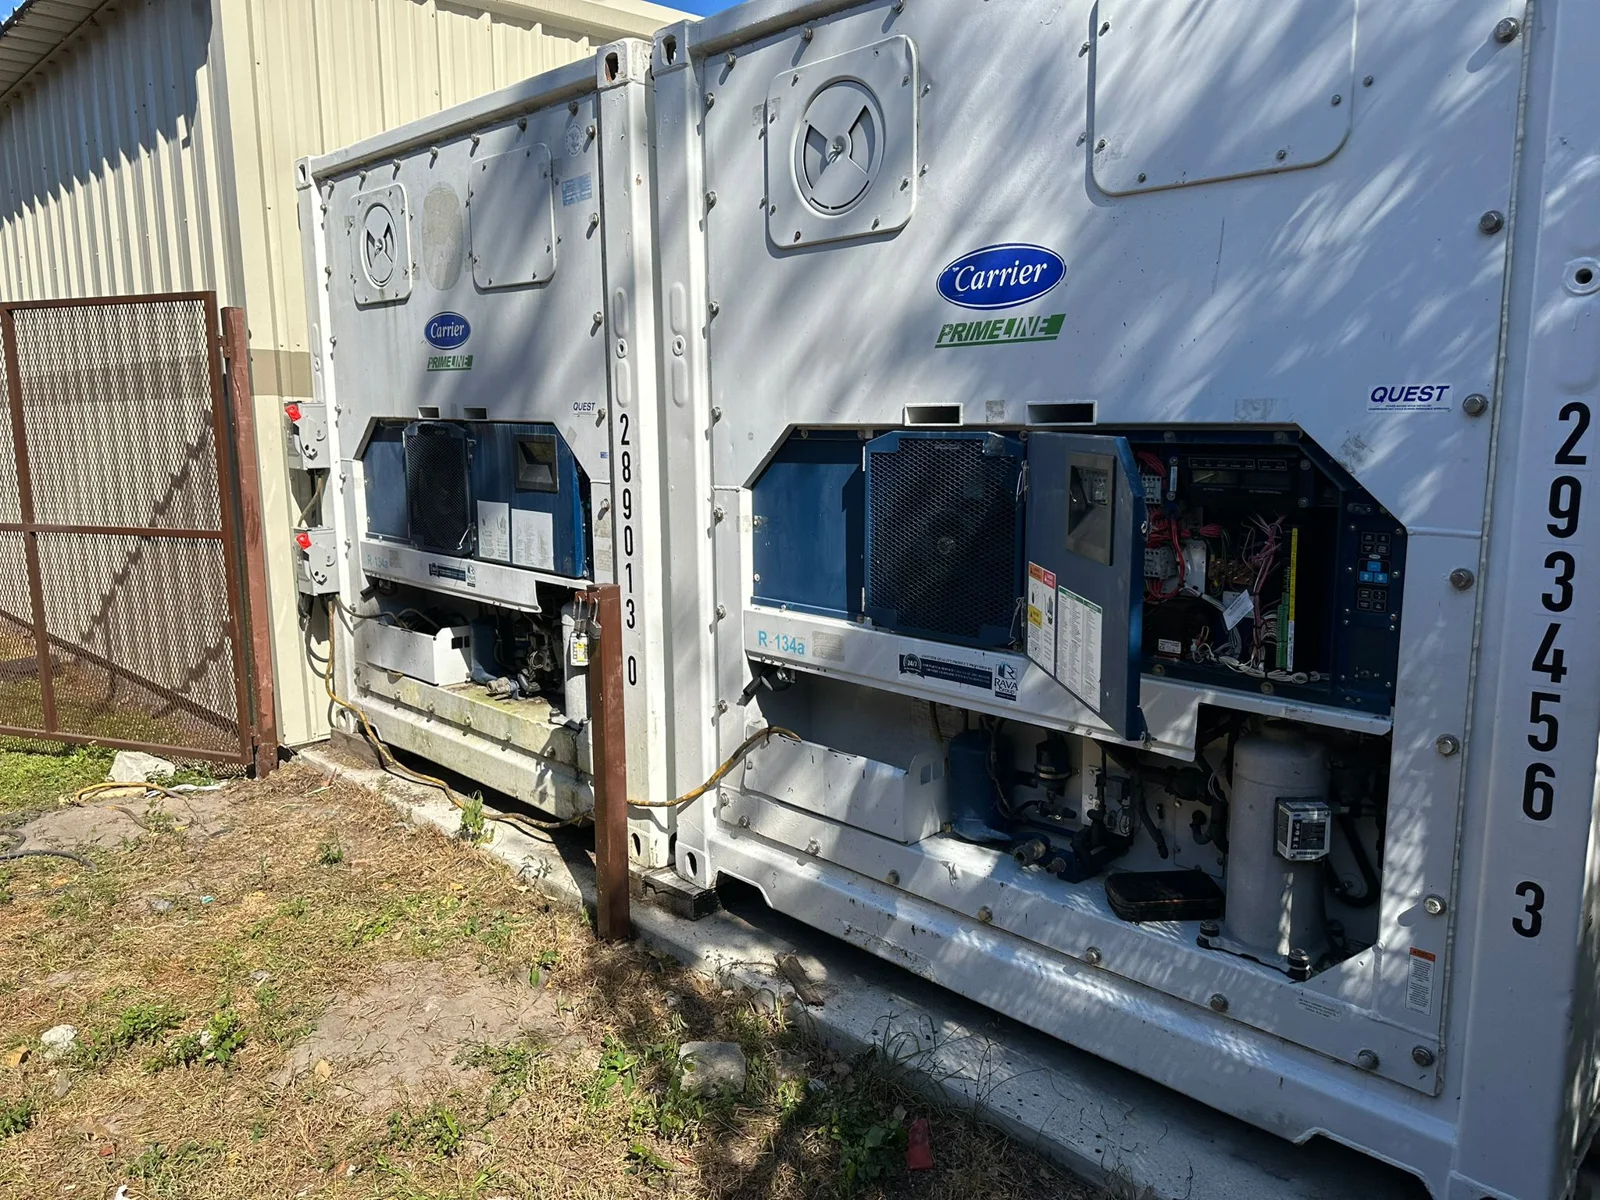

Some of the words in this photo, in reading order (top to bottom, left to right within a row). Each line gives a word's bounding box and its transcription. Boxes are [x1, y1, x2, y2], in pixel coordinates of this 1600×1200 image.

[955, 260, 1048, 292] Carrier
[430, 321, 465, 339] Carrier
[936, 314, 1065, 344] PRIMELINE
[1370, 385, 1450, 403] QUEST
[572, 401, 596, 412] QUEST
[994, 677, 1019, 691] RAVA
